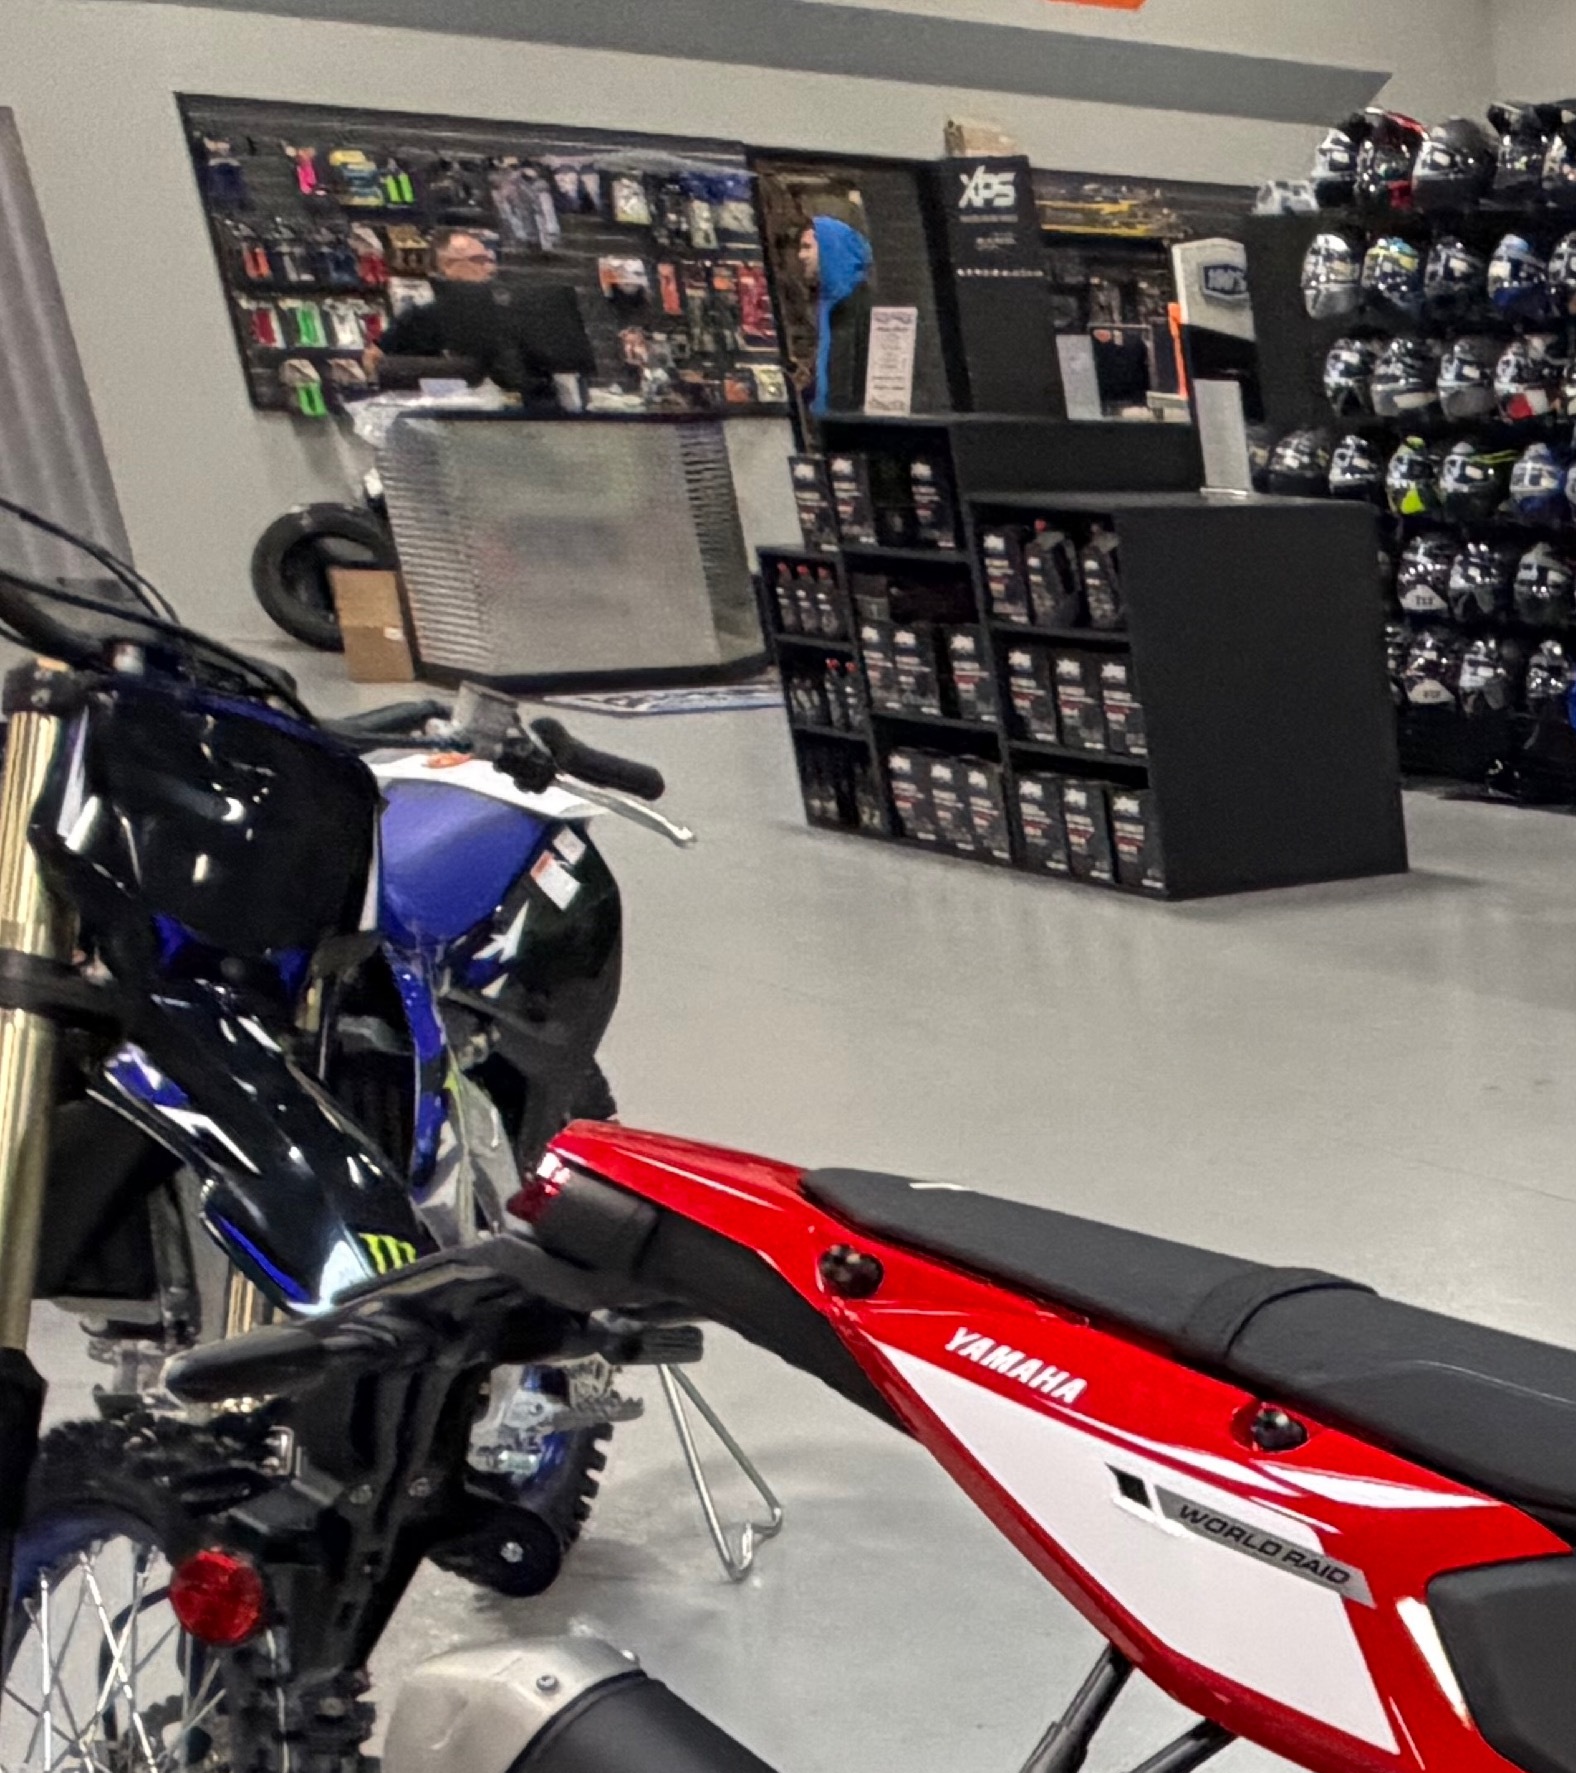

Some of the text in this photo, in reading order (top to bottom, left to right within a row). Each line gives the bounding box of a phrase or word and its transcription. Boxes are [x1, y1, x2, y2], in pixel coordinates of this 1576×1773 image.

[958, 165, 1017, 209] XPS
[944, 1327, 1088, 1404] YAMAHA
[1178, 1504, 1351, 1586] WORLD RAID
